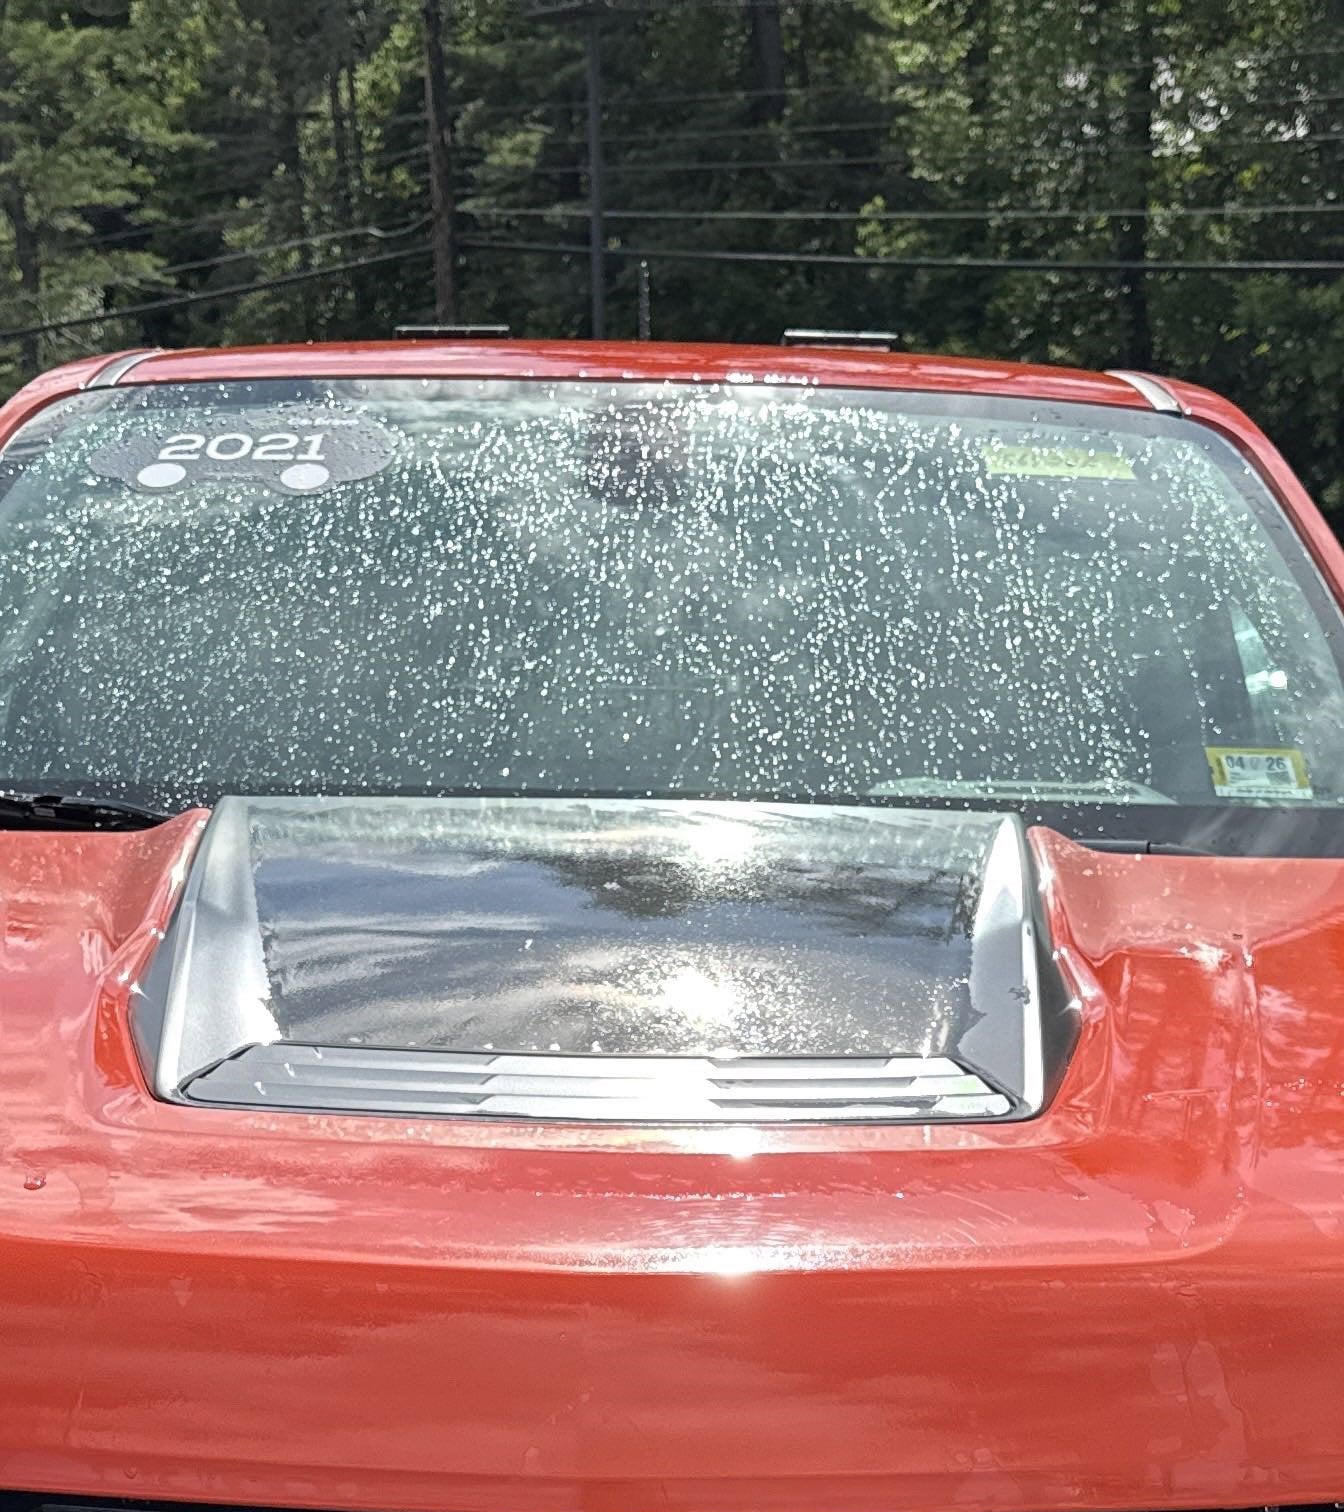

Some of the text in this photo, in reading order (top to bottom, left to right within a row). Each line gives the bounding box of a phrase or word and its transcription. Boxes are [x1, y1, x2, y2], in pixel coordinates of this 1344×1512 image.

[157, 432, 329, 461] 2021
[1225, 756, 1288, 771] 04 26
